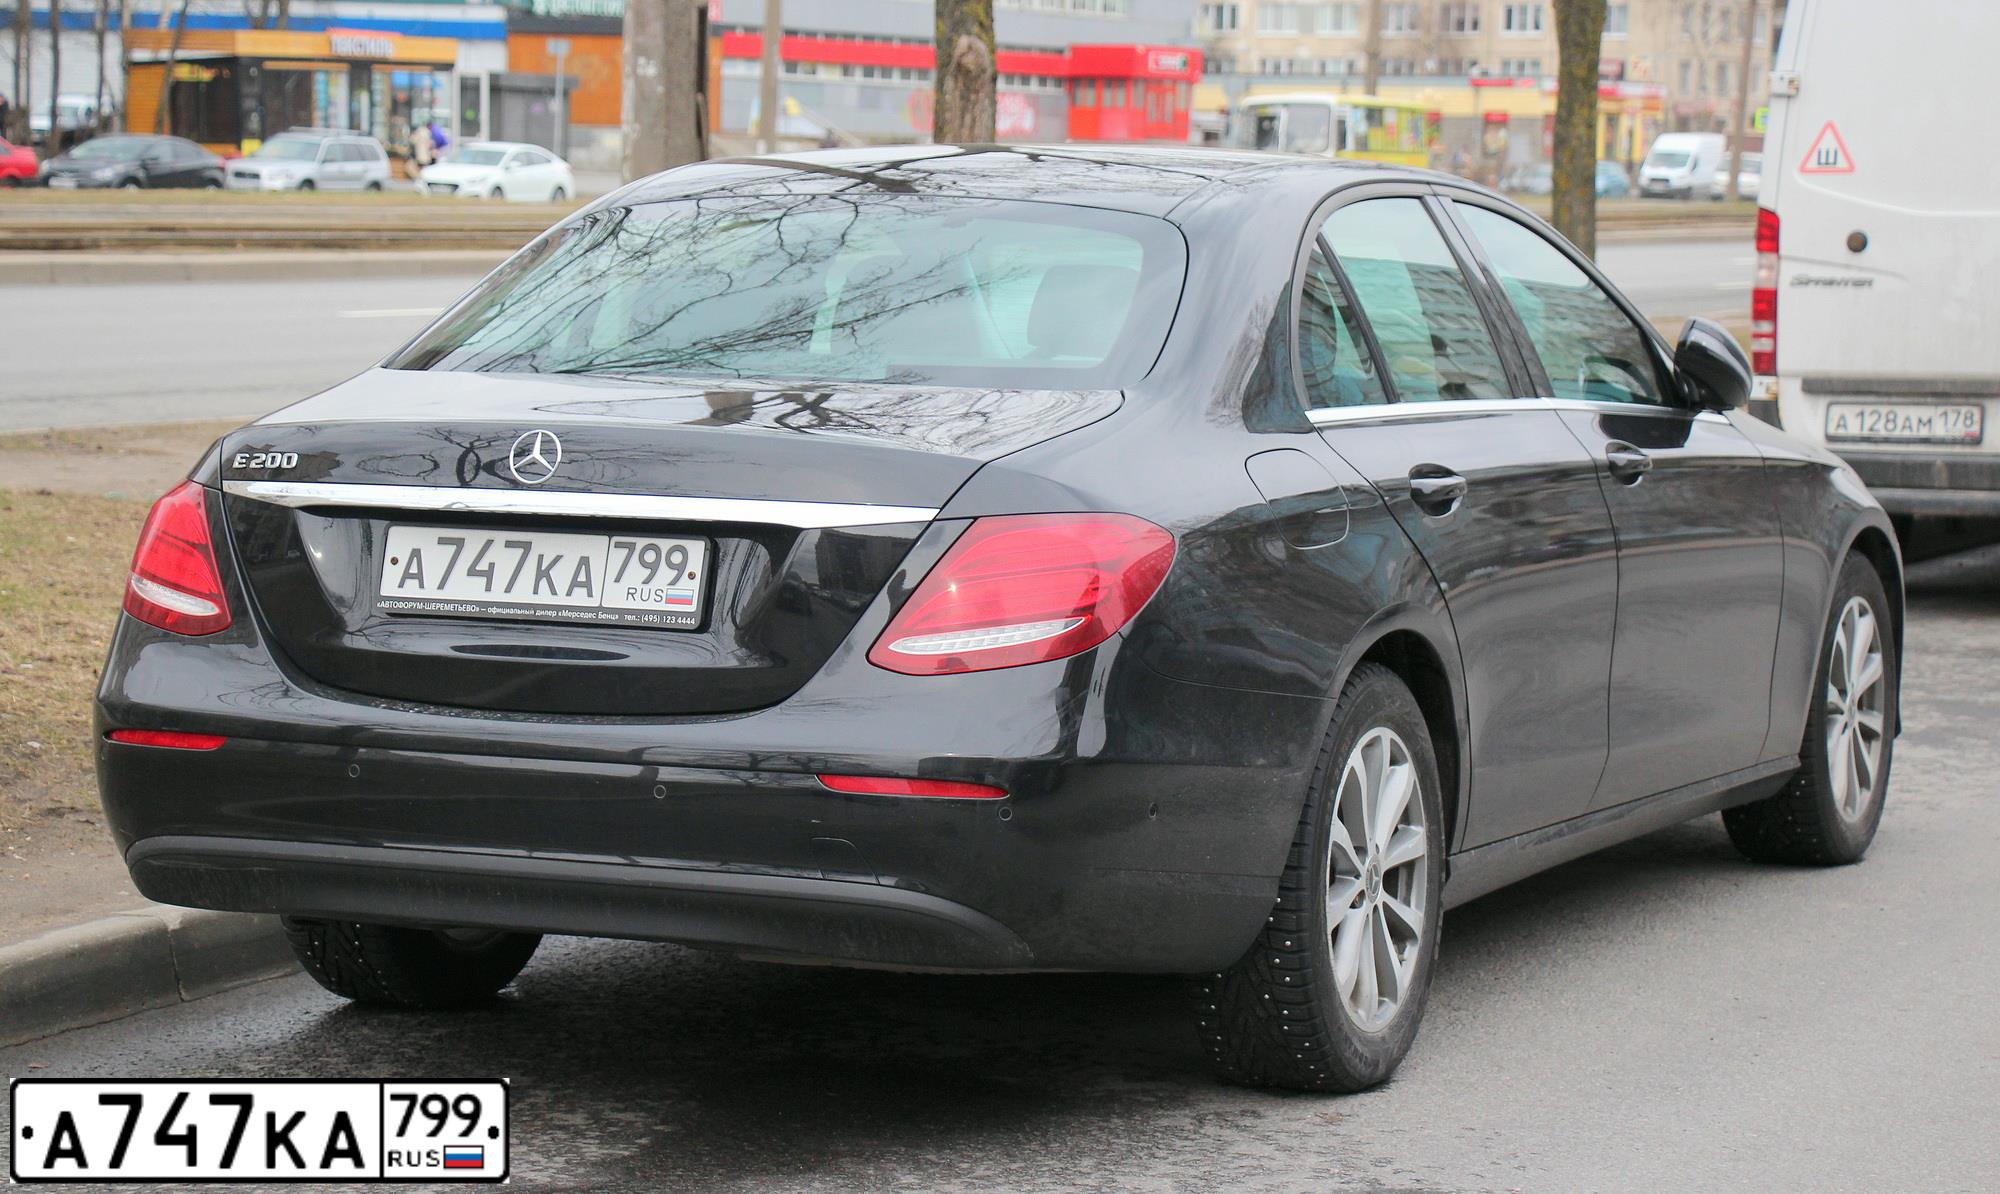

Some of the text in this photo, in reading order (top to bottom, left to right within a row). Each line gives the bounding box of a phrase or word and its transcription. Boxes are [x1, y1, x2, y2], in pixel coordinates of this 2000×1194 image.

[1817, 148, 1837, 166] Ш
[1835, 409, 1975, 433] А128АМ 178
[232, 452, 299, 469] E200
[397, 536, 690, 598] А747КА 799
[625, 586, 664, 604] RUS
[377, 600, 480, 613] «АВТОФОРУМ-ШЕРЕМЕТЬЕВО»
[487, 606, 535, 615] официальный
[535, 609, 557, 618] дилер
[558, 609, 597, 619] «Мерседес
[598, 611, 619, 621] Бенц»
[641, 614, 660, 624] (495)
[662, 615, 676, 624] 123
[677, 616, 696, 625] 4444
